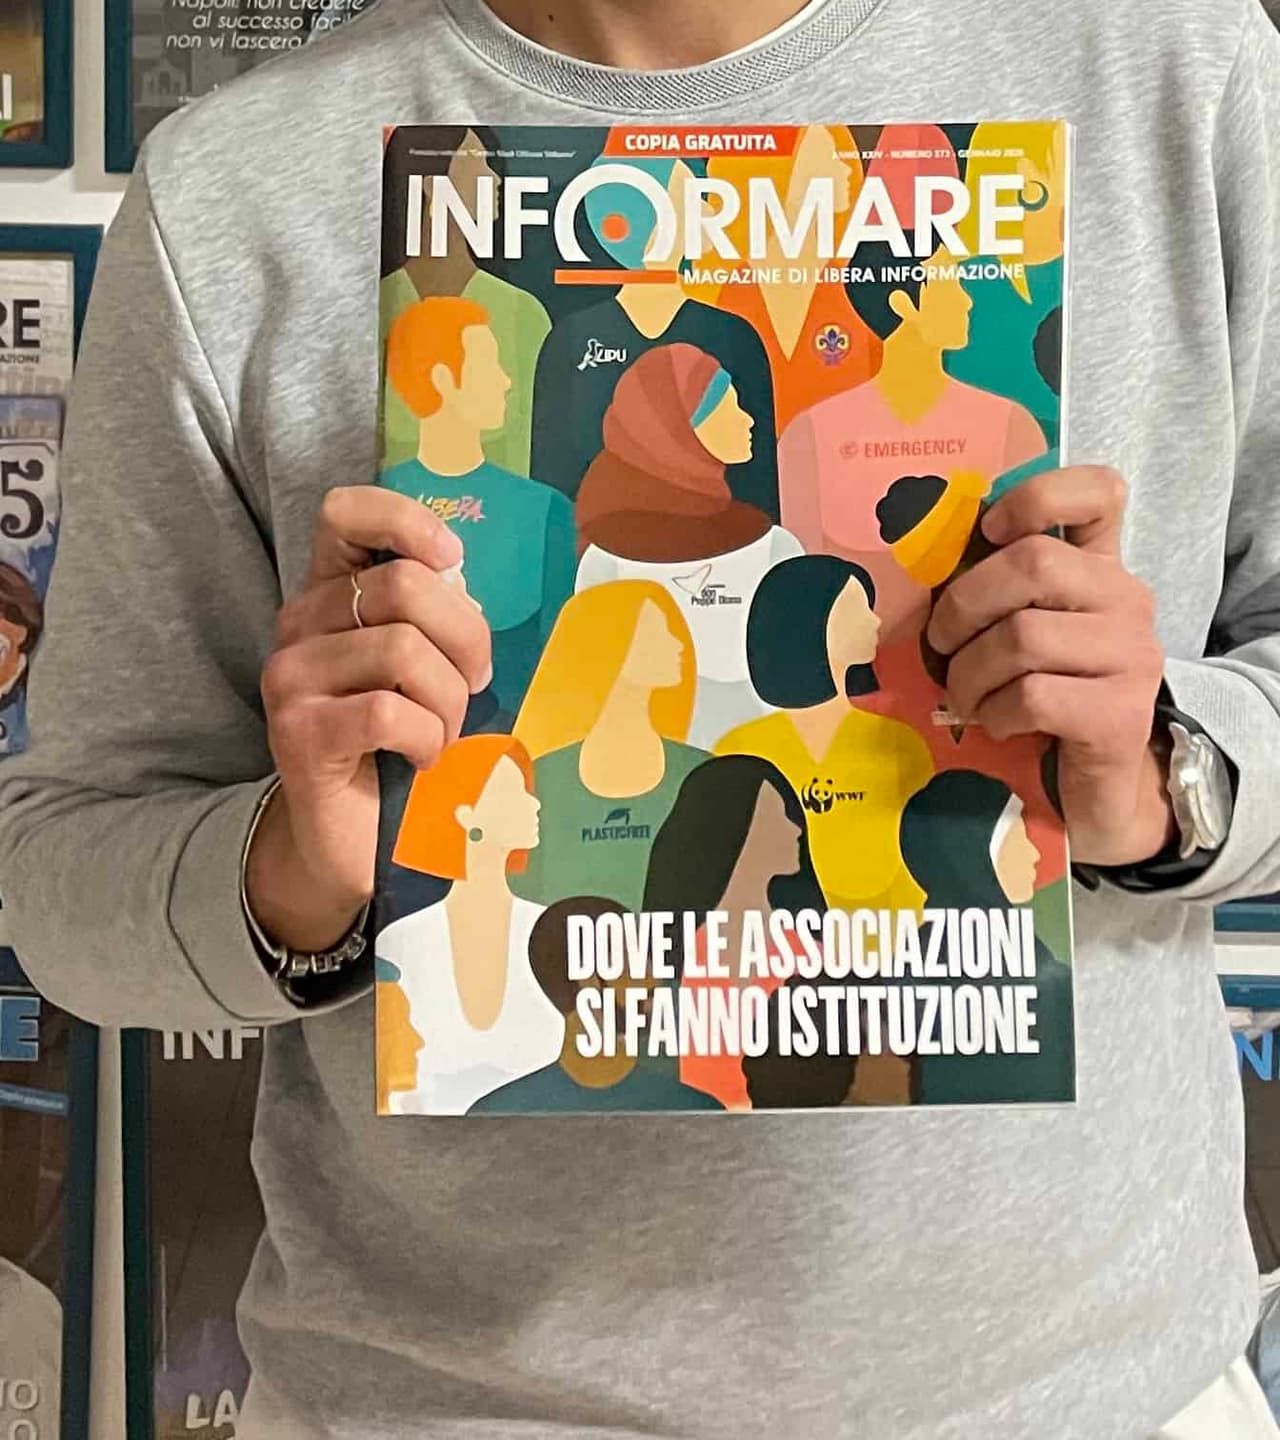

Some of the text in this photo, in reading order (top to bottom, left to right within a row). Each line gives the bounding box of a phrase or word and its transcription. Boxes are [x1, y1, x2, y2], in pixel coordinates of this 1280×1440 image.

[192, 13, 304, 31] al successo
[166, 34, 224, 51] non vi
[625, 134, 776, 151] COPIA GRATUITA
[404, 164, 1025, 262] INFORMARE
[683, 264, 1024, 285] MAGAZINE DI LIBERA INFORMAZIONE
[863, 438, 968, 458] EMERGENCY
[835, 791, 866, 802] WWF
[567, 907, 1037, 981] DOVE LE ASSOCIAZIONI
[575, 984, 1041, 1058] SI FANNO ISTITUZIONE
